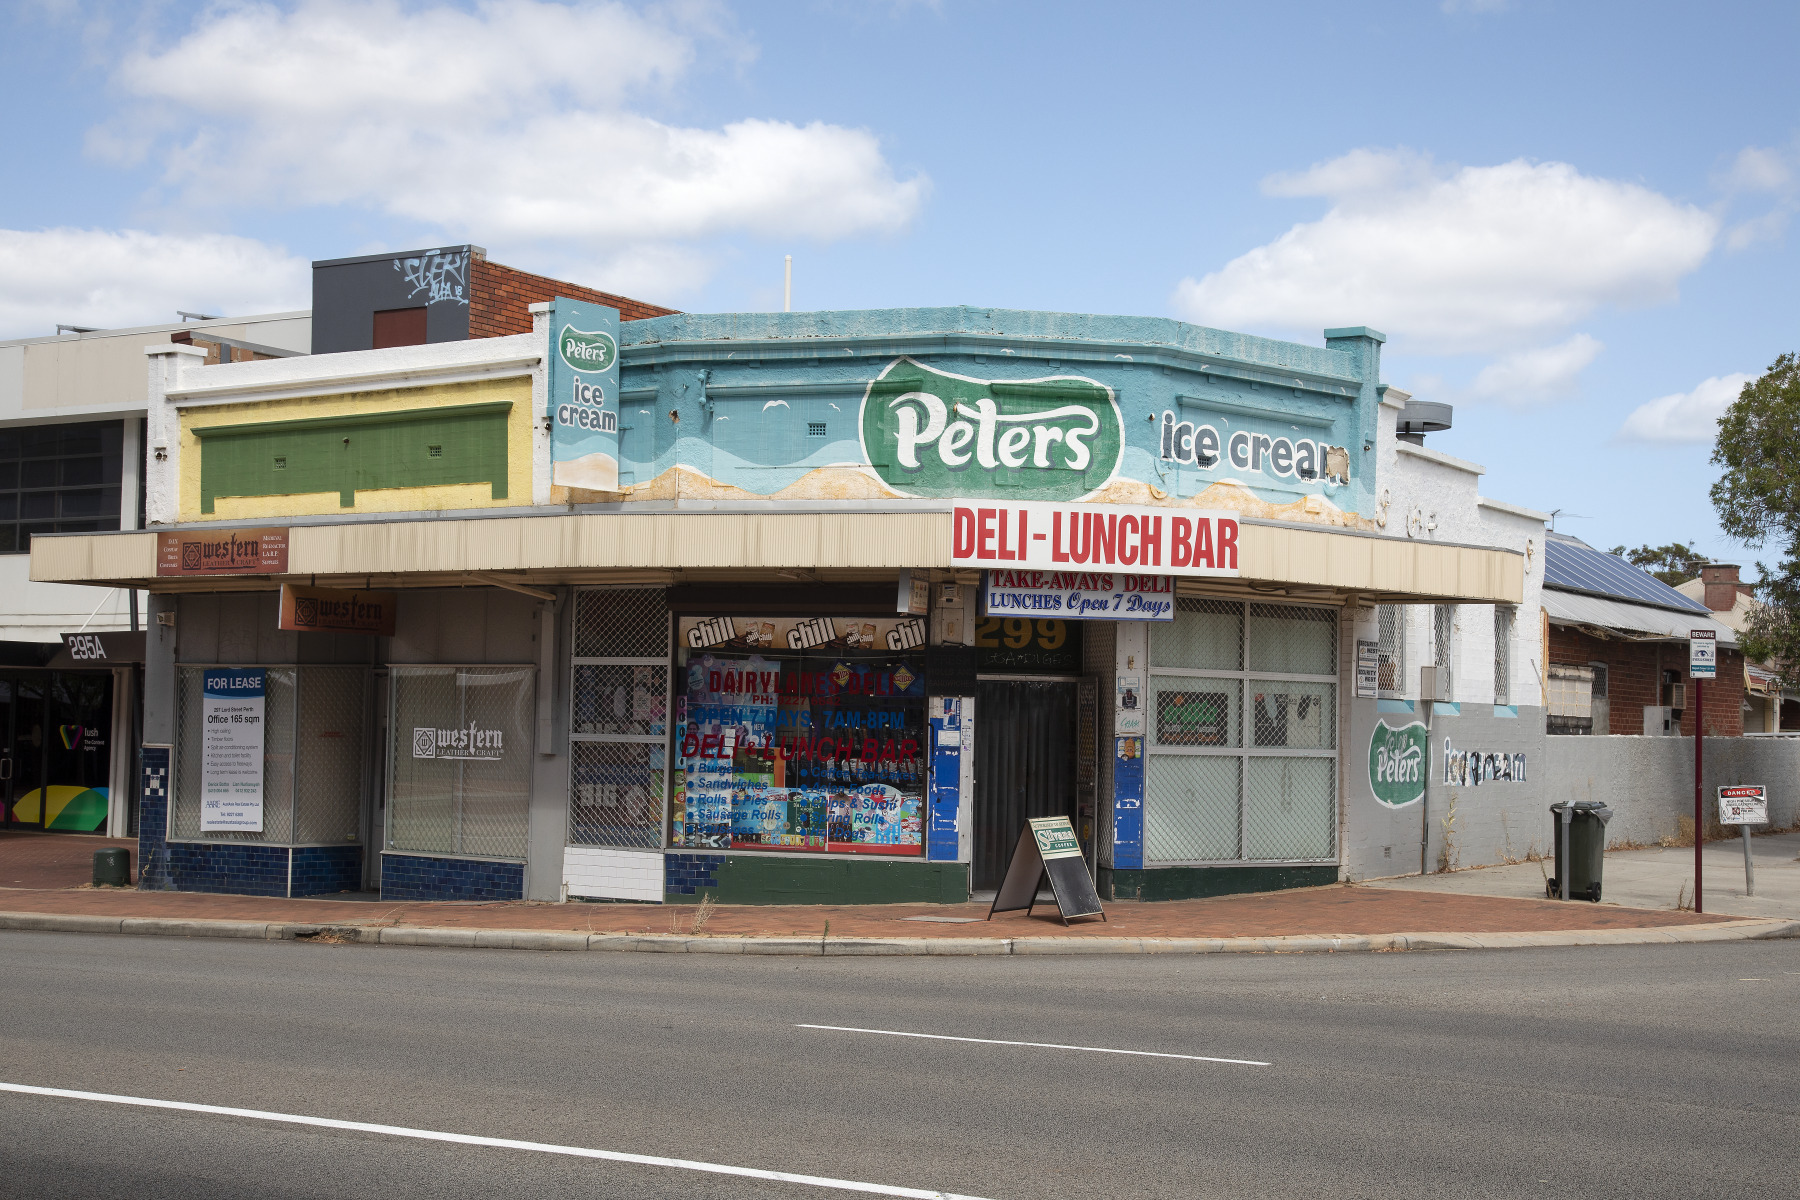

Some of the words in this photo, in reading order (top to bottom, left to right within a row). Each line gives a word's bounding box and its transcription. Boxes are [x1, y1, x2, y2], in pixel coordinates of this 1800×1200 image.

[565, 338, 607, 362] Peters
[573, 376, 604, 407] ice
[557, 403, 617, 434] cream
[889, 391, 1100, 471] Peters
[1160, 410, 1221, 471] ice
[203, 532, 260, 566] western
[1170, 516, 1240, 570] BAR
[989, 569, 1114, 592] TAKE-AWAYS
[1122, 575, 1173, 594] DELI
[319, 594, 382, 625] western
[990, 592, 1062, 610] LUNCHES
[1066, 591, 1110, 615] Open
[1112, 593, 1124, 611] 7
[1127, 594, 1171, 617] Days
[687, 616, 736, 648] chill
[786, 617, 836, 650] chill
[975, 616, 1067, 650] 299
[68, 635, 107, 660] 295A
[207, 678, 228, 690] FOR
[230, 677, 262, 689] LEASE
[848, 671, 895, 696] DELI
[752, 695, 773, 705] PH:
[777, 695, 808, 706] 9227
[207, 714, 228, 724] Office
[231, 714, 243, 723] 165
[244, 716, 260, 725] sqm
[694, 707, 743, 726] OPEN
[749, 709, 761, 727] 7
[765, 710, 811, 728] DAYS
[822, 710, 905, 730] 7AM-8PM
[84, 727, 99, 737] lush
[437, 720, 503, 756] western
[437, 748, 469, 757] LEATHER
[682, 733, 741, 760] DELI
[744, 741, 757, 755] &
[762, 735, 853, 763] LUNCH
[861, 738, 918, 764] BAR
[698, 763, 745, 776] Burgers
[812, 766, 917, 781] Coffee-Tea-Cakes
[1377, 745, 1422, 783] Peters
[698, 778, 768, 790] Sandwiches
[812, 782, 845, 794] Asian
[849, 783, 887, 795] Foods
[697, 793, 727, 805] Rolls
[742, 794, 768, 806] Pies
[811, 797, 845, 810] Chips
[850, 798, 858, 809] &
[862, 798, 897, 811] Sushi
[698, 808, 748, 822] Sausage
[751, 809, 781, 820] Rolls
[811, 811, 851, 826] Spring
[854, 813, 885, 825] Rolls
[697, 823, 754, 837] Sausages
[811, 827, 832, 838] Hot
[835, 828, 866, 841] Dogs
